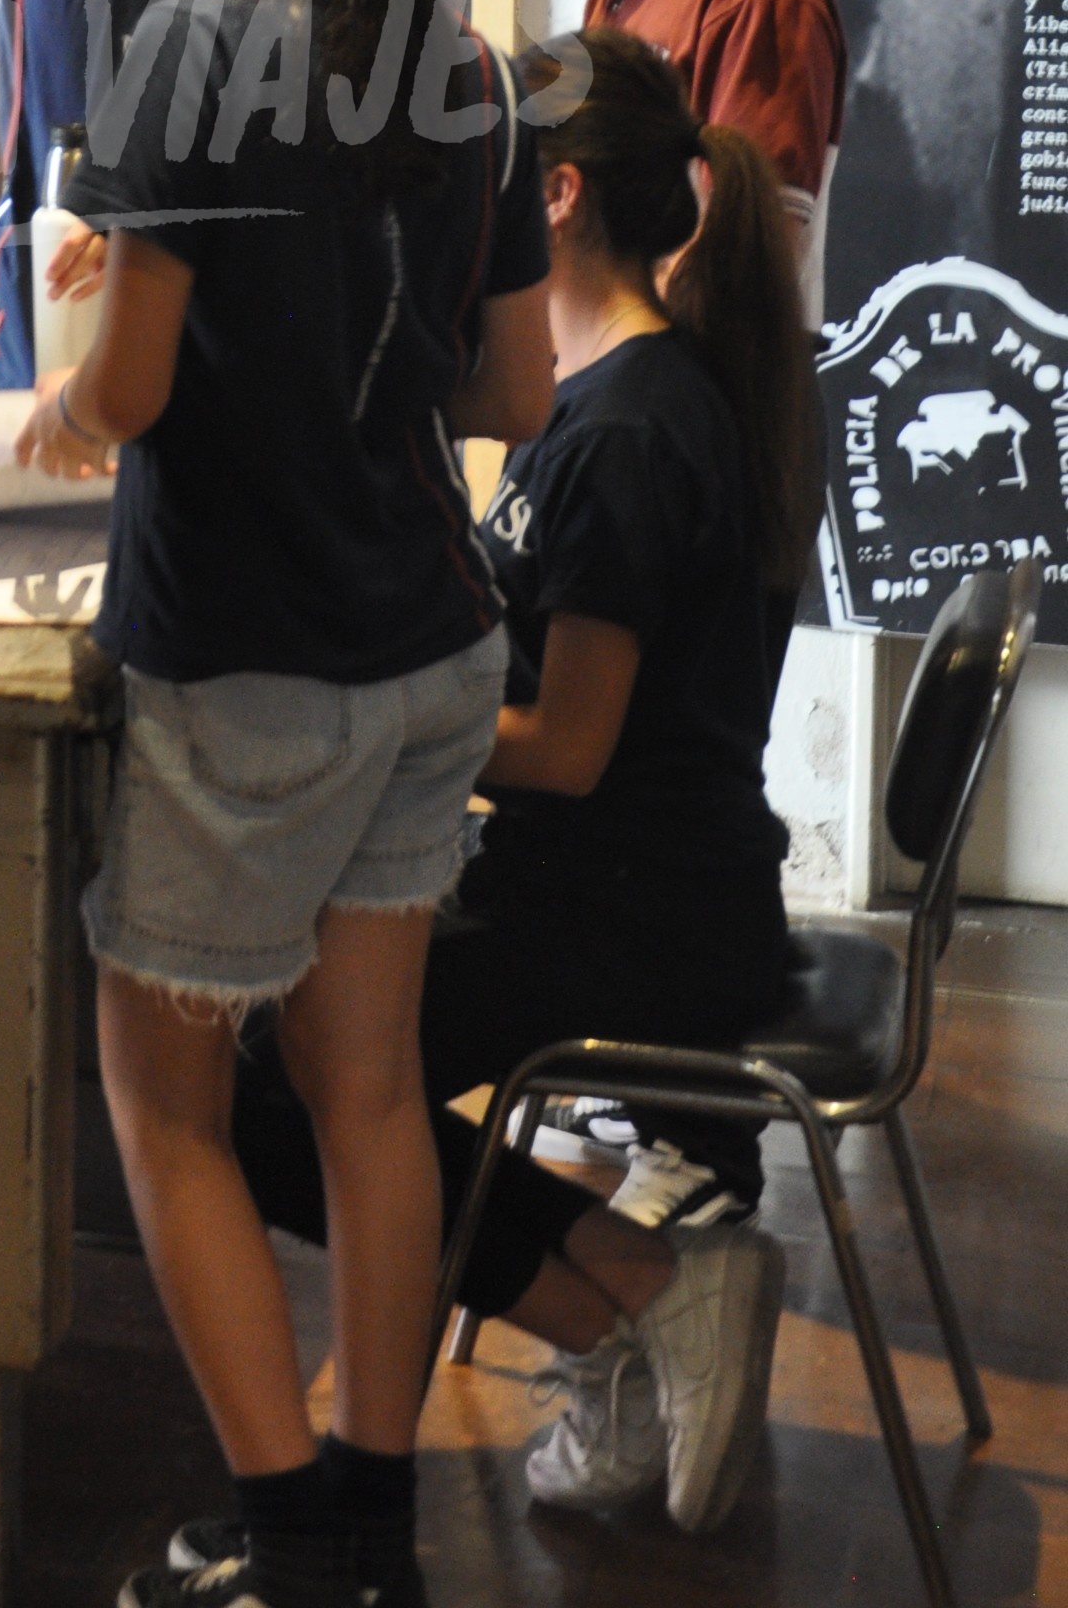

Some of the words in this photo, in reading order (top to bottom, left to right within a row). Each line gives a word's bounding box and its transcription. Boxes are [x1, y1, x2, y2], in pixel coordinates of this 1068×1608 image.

[1022, 108, 1068, 124] cont
[1020, 150, 1068, 171] gobi
[845, 394, 886, 533] POLICIA
[869, 334, 923, 389] DE
[928, 311, 978, 345] LA
